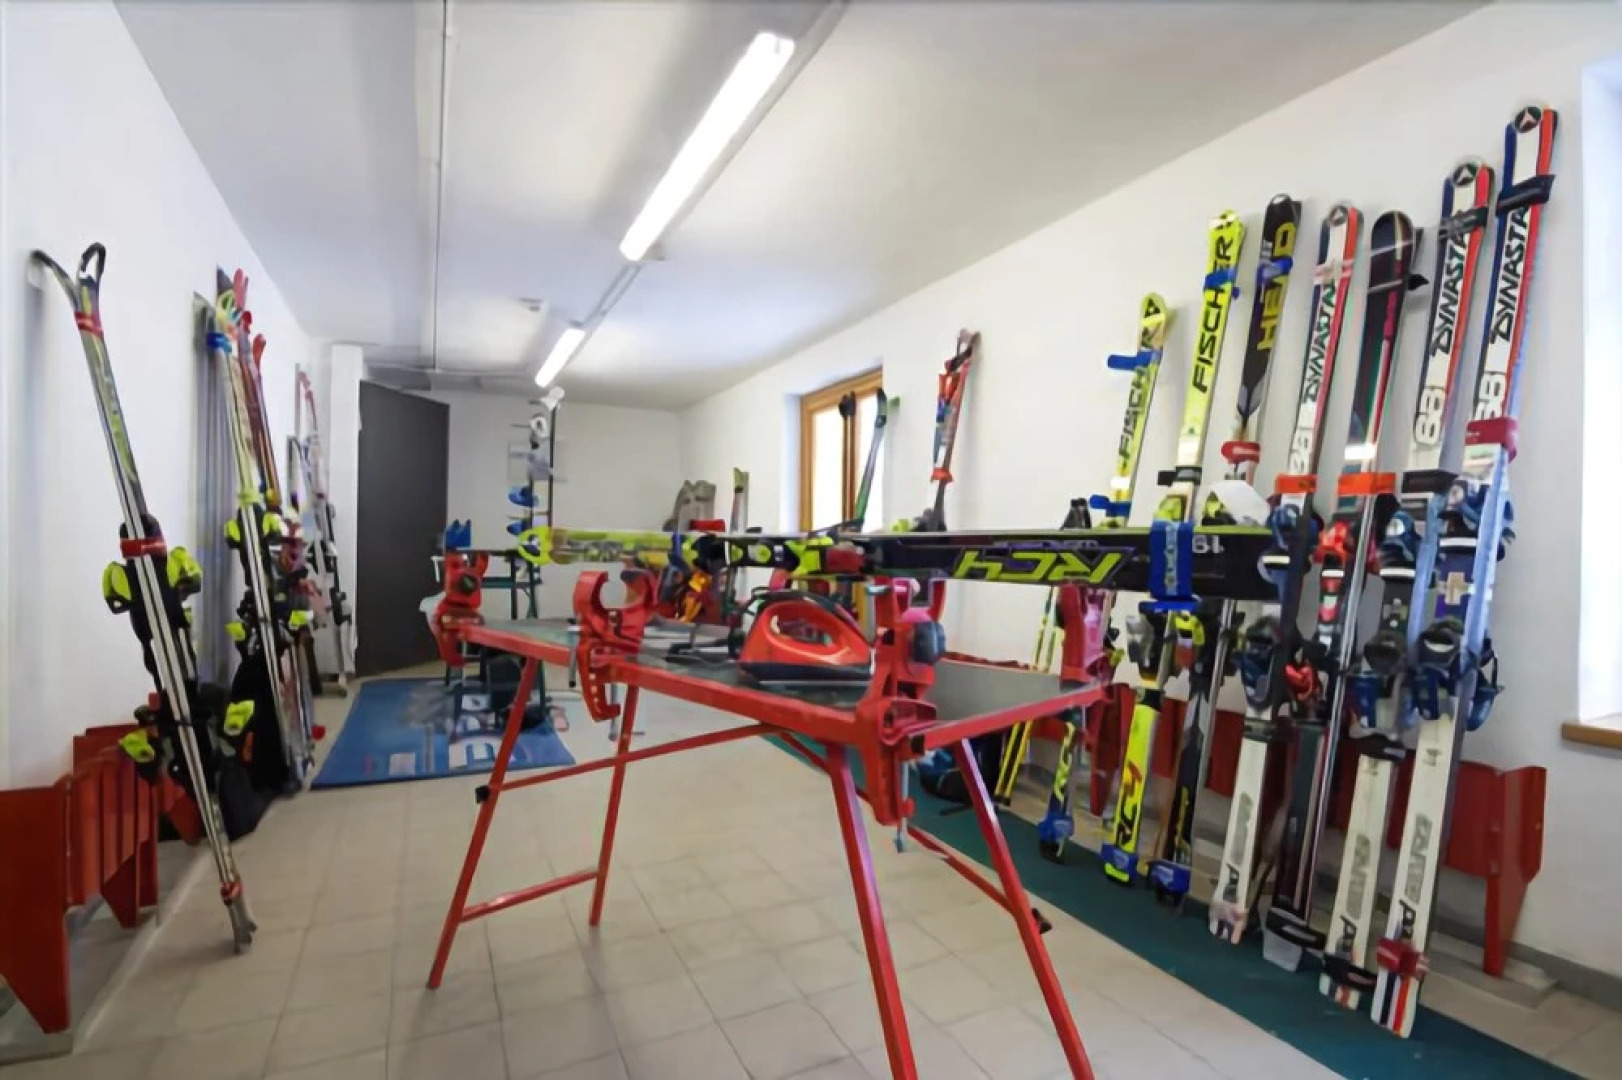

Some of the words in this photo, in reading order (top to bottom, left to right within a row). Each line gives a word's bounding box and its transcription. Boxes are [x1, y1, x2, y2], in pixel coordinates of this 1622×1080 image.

[1257, 222, 1297, 350] HED
[1431, 231, 1468, 357] DYNASTA
[1490, 205, 1529, 344] DYNASTA
[1301, 282, 1337, 404] DYNASTA
